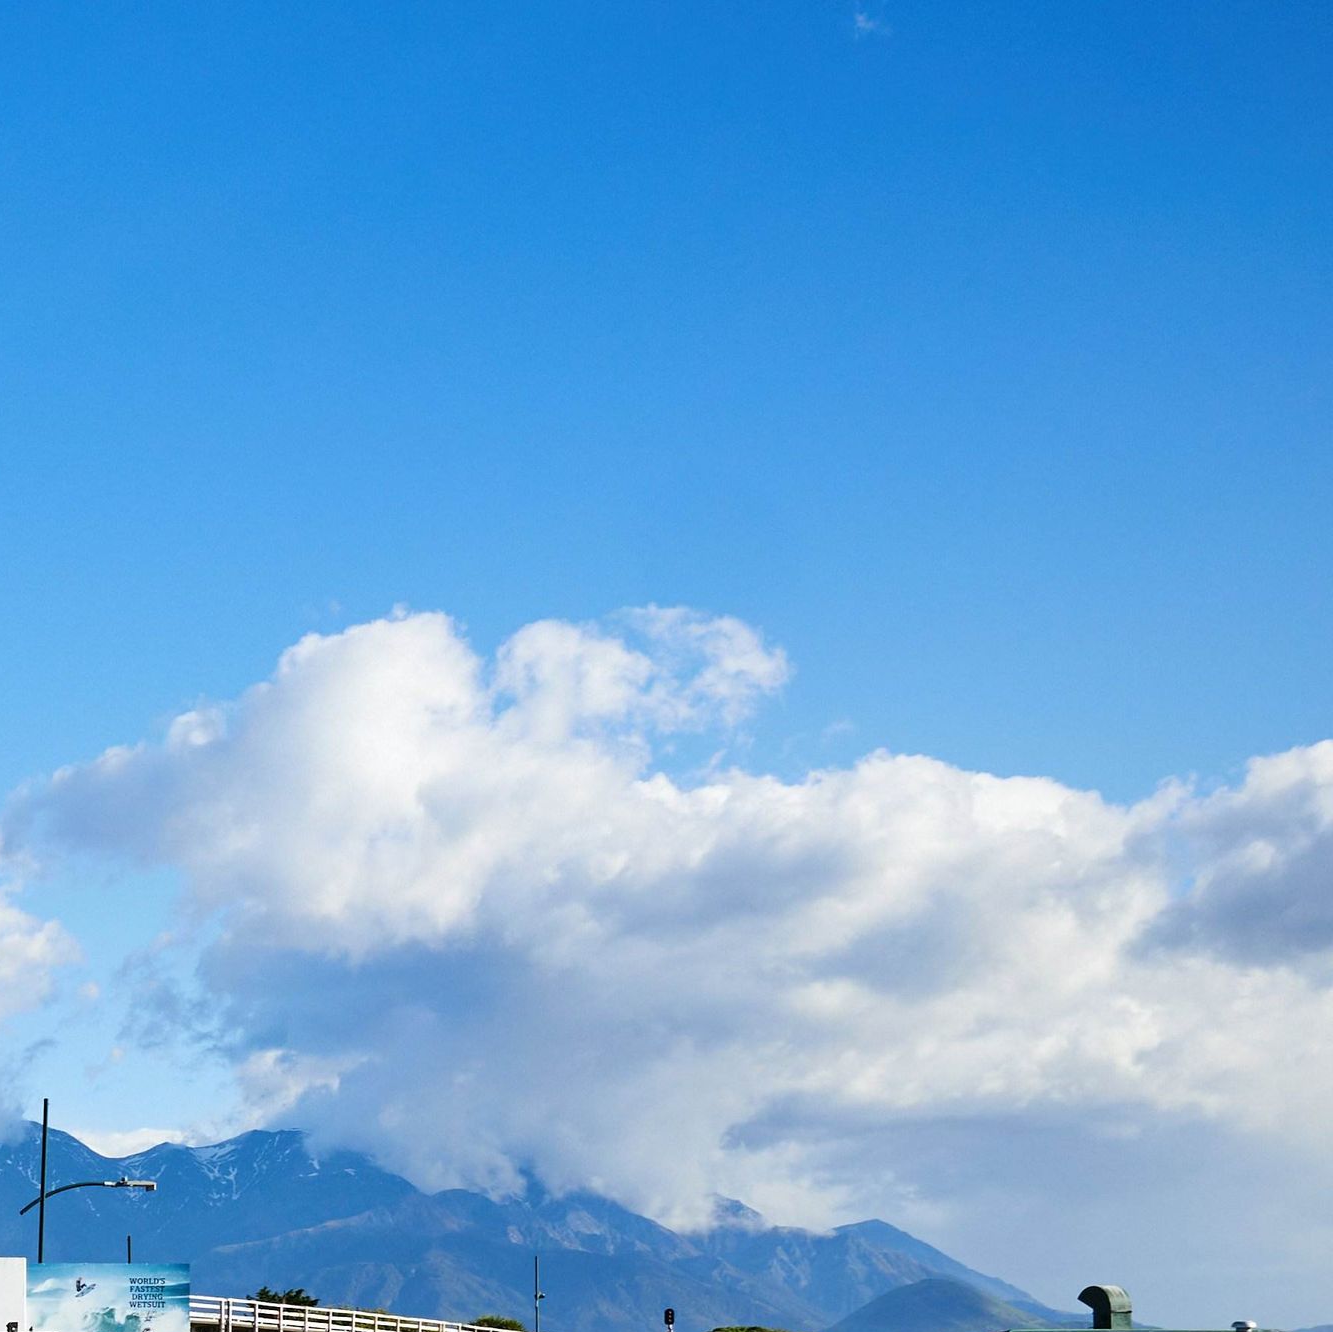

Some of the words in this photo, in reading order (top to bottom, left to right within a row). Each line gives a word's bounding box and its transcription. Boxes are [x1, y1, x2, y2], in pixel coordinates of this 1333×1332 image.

[129, 1277, 166, 1285] WORLD'S
[129, 1285, 166, 1293] FASTEST
[131, 1293, 163, 1301] DRYING
[129, 1301, 166, 1309] WETSUIT
